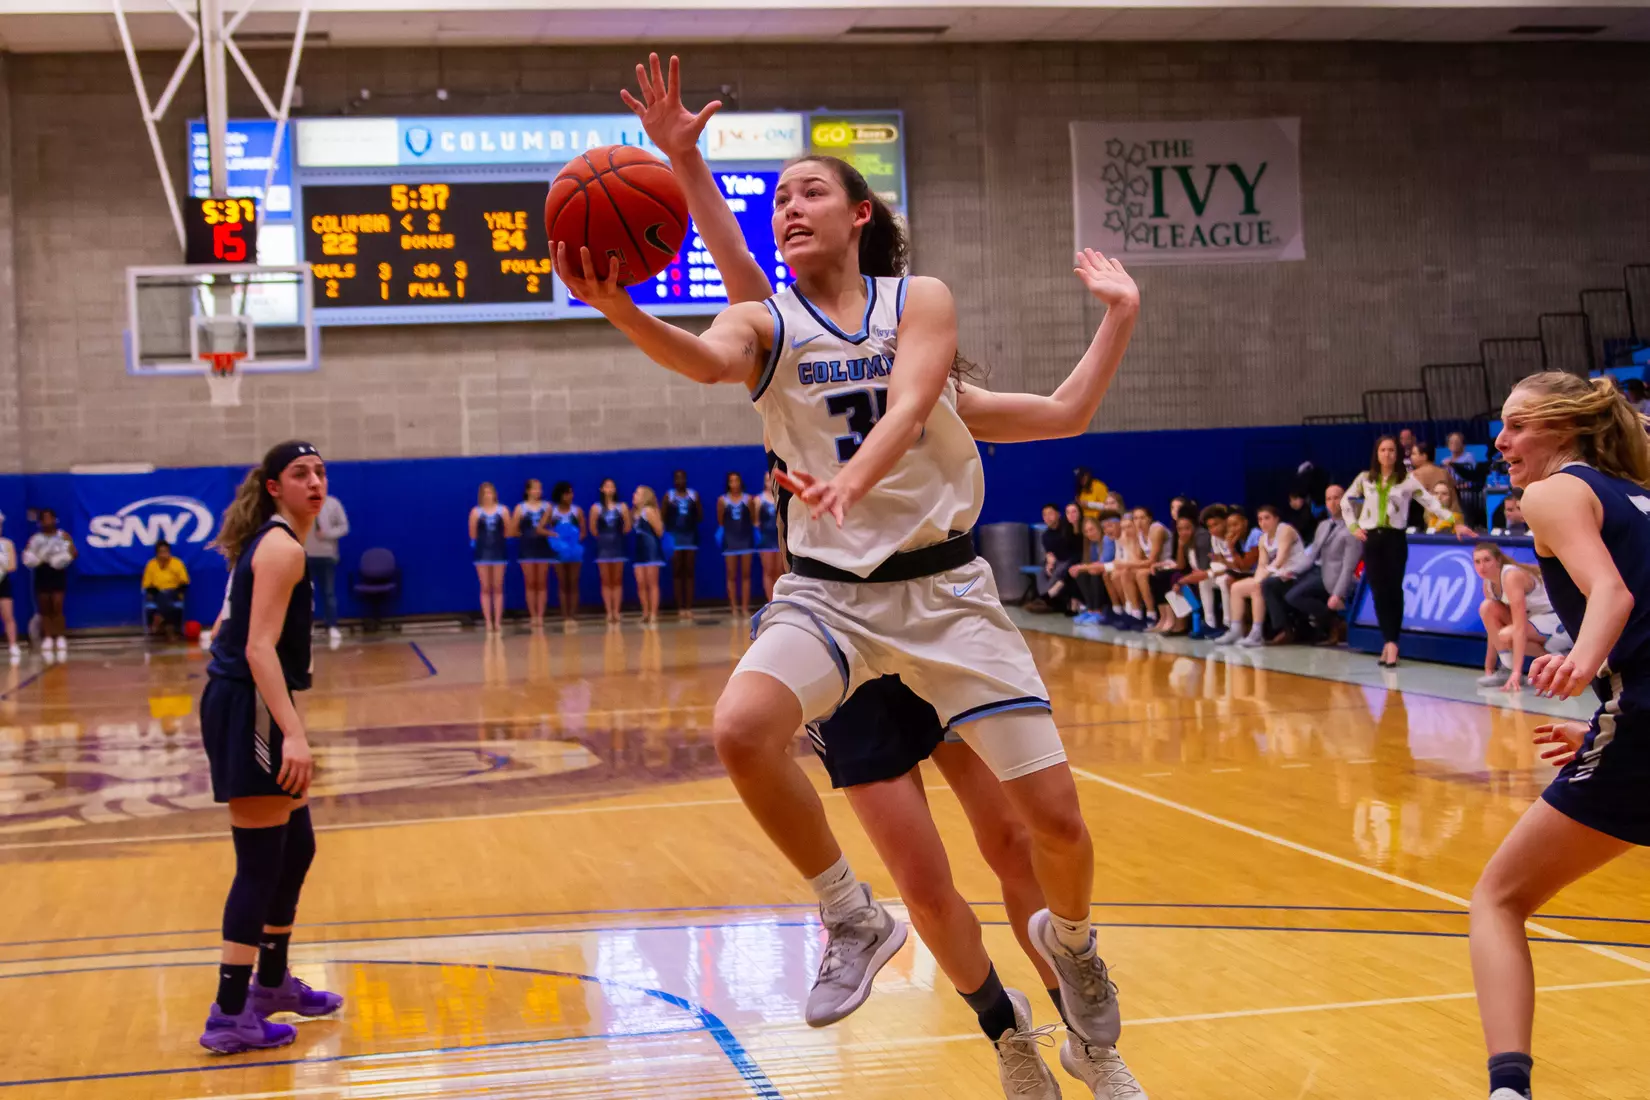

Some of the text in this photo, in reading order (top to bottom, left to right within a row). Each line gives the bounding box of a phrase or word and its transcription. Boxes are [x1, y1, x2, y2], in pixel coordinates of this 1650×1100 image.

[440, 130, 604, 152] COLUMBIA
[816, 126, 846, 142] GO
[1147, 139, 1195, 159] THE
[721, 174, 765, 195] Yale
[1147, 162, 1268, 219] IVY
[391, 184, 450, 211] 5:37
[202, 199, 255, 224] 5:37
[483, 211, 528, 230] YALE
[311, 213, 391, 234] COLUMBIA
[427, 213, 441, 232] 2
[213, 223, 247, 262] 15
[322, 232, 358, 255] 22
[400, 233, 455, 250] BONUS
[491, 229, 527, 252] 24
[1151, 221, 1272, 249] LEAGUE
[378, 262, 392, 281] 3
[454, 260, 468, 279] 3
[500, 258, 552, 275] FOULS
[325, 279, 339, 298] 2
[380, 279, 465, 300] 1 FULL 1
[526, 274, 540, 293] 2
[824, 389, 888, 464] 3
[86, 512, 192, 549] SNY
